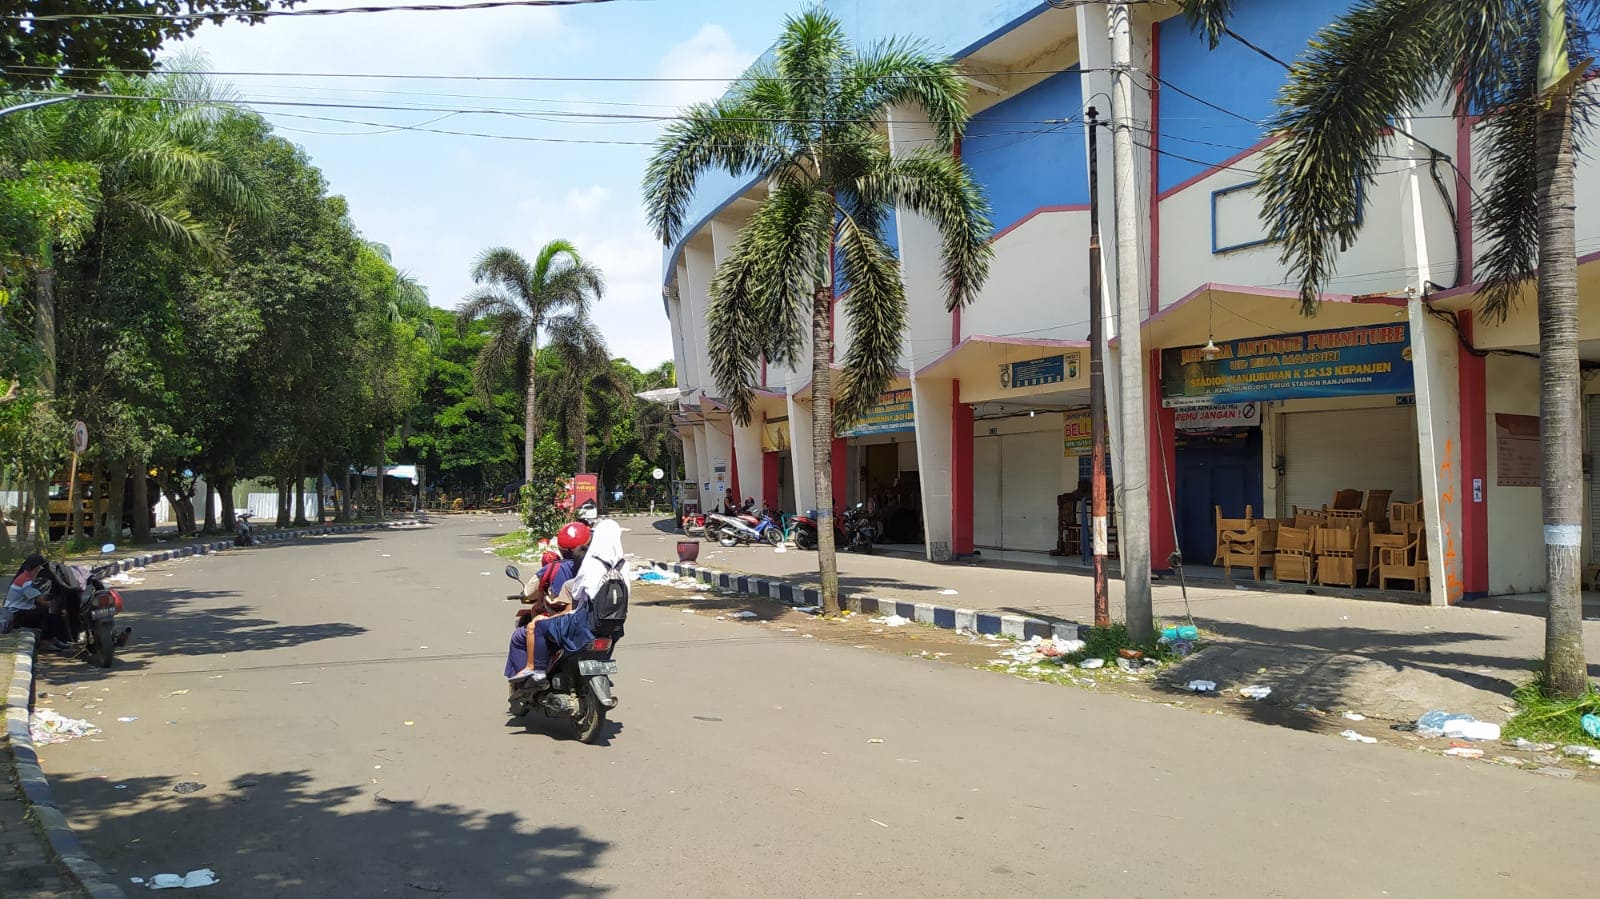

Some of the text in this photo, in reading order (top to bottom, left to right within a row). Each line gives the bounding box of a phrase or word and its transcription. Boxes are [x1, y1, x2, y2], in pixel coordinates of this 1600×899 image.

[1238, 338, 1303, 357] ANTIQUE
[1308, 326, 1405, 350] FURNITURE
[1282, 351, 1340, 365] MANDIRI
[1191, 376, 1227, 387] STADION
[1230, 371, 1291, 384] KANJURUHAN
[1303, 367, 1332, 378] 12-13
[1335, 363, 1391, 376] KEPANJEN
[1292, 380, 1321, 388] STADION
[1322, 377, 1372, 385] KANJURUHAN
[1200, 410, 1235, 419] JANGAN
